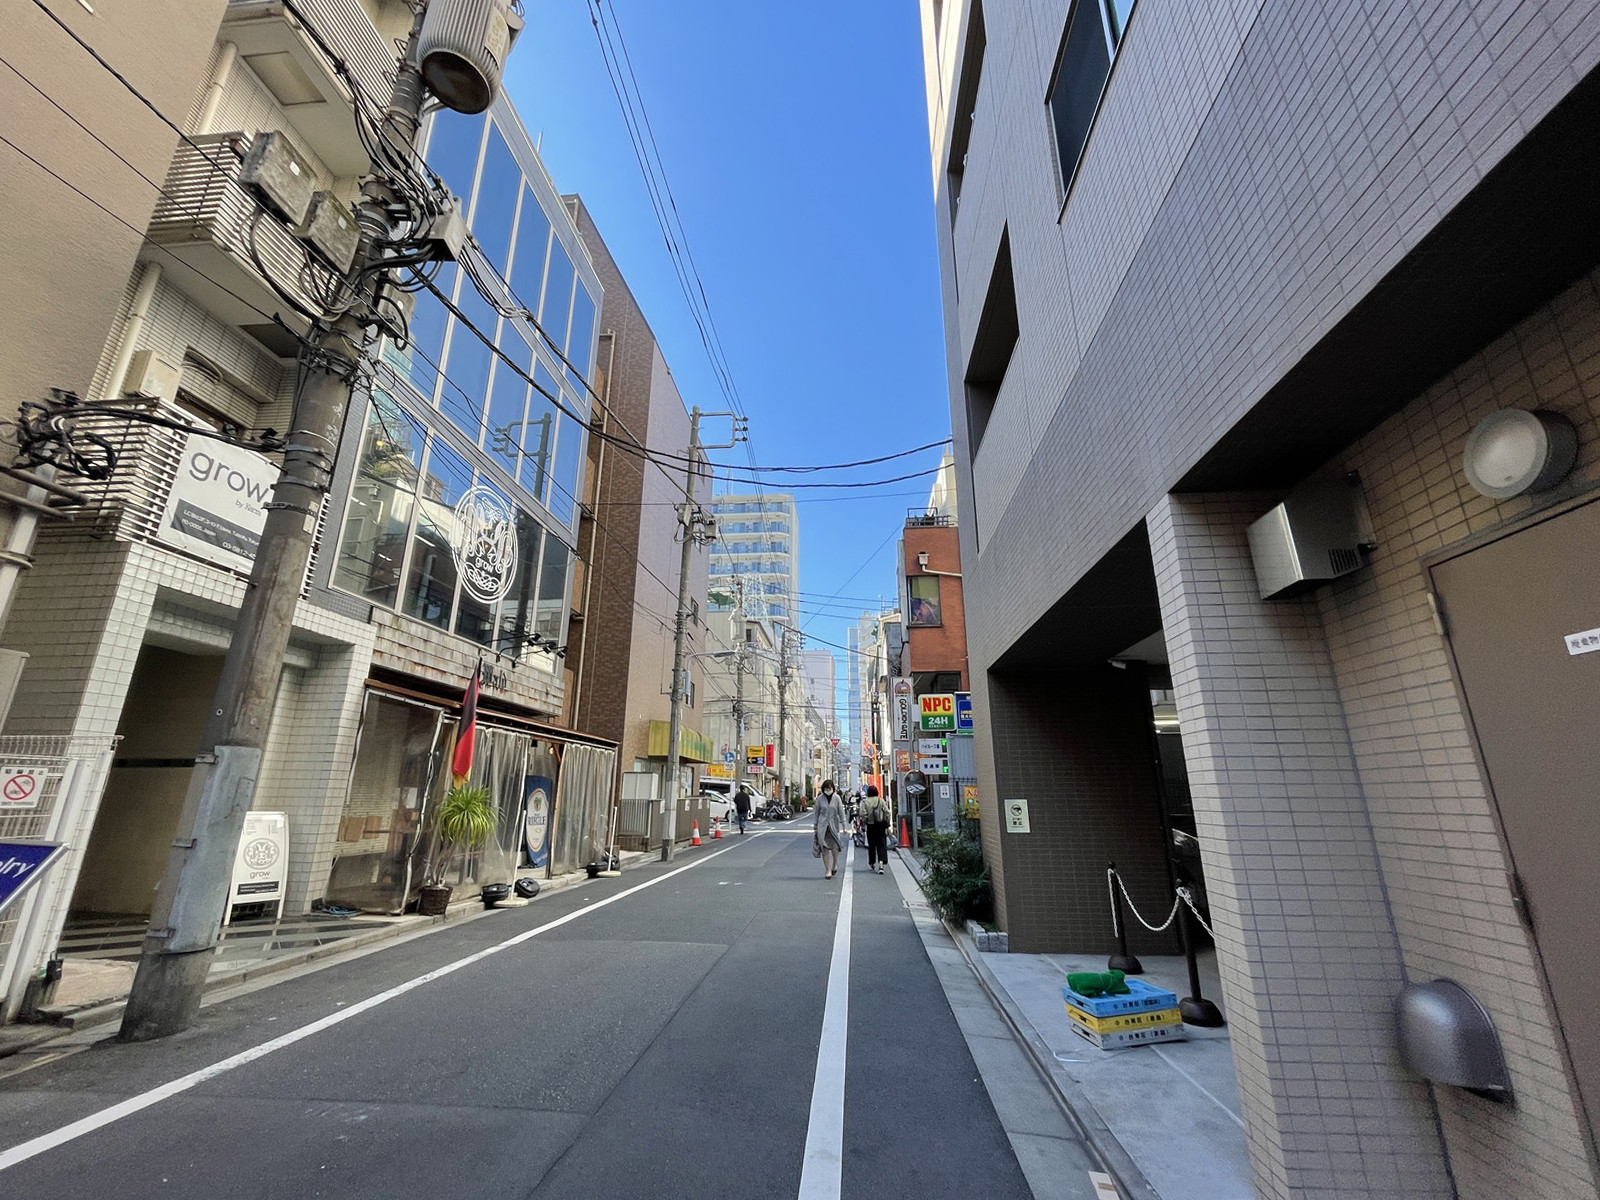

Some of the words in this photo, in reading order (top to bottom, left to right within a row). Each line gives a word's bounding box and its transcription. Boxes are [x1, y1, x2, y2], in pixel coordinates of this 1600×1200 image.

[189, 452, 269, 503] grow
[475, 557, 494, 573] grow
[922, 697, 952, 712] NPC
[928, 716, 949, 725] 24H
[249, 870, 271, 879] grow
